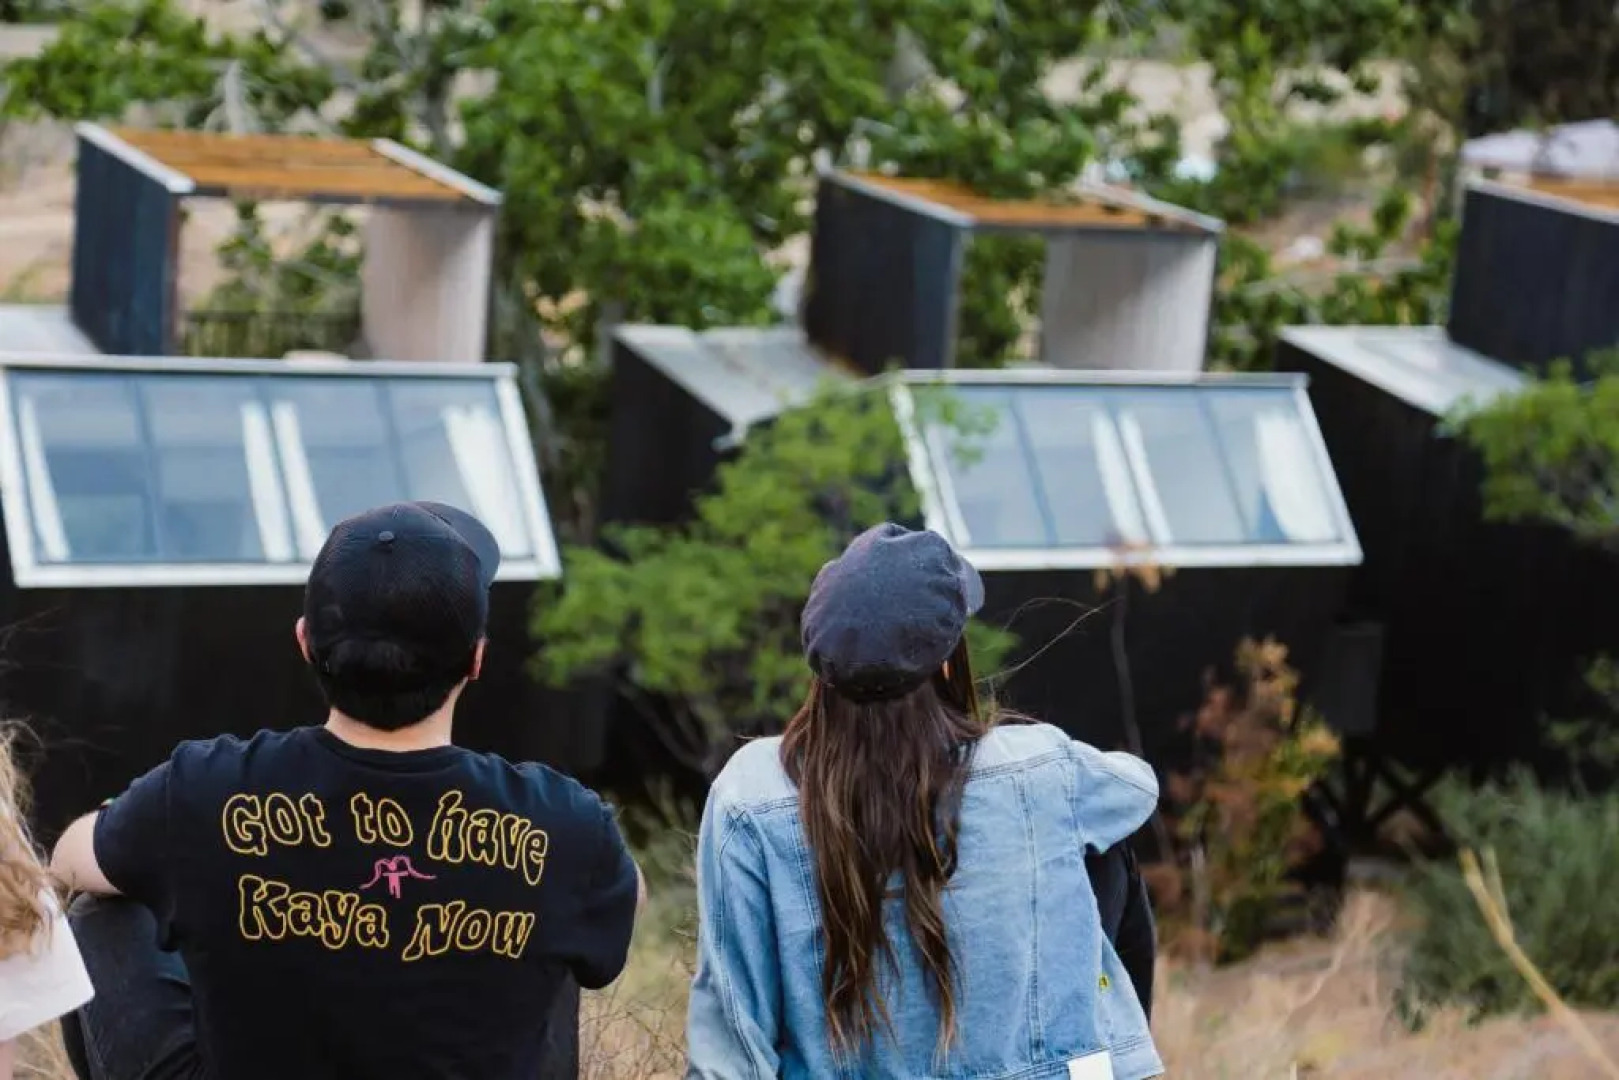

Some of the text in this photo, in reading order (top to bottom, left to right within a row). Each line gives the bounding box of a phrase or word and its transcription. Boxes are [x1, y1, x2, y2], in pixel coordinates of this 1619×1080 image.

[223, 790, 548, 885] Got to have
[239, 874, 535, 962] Kaya Now
